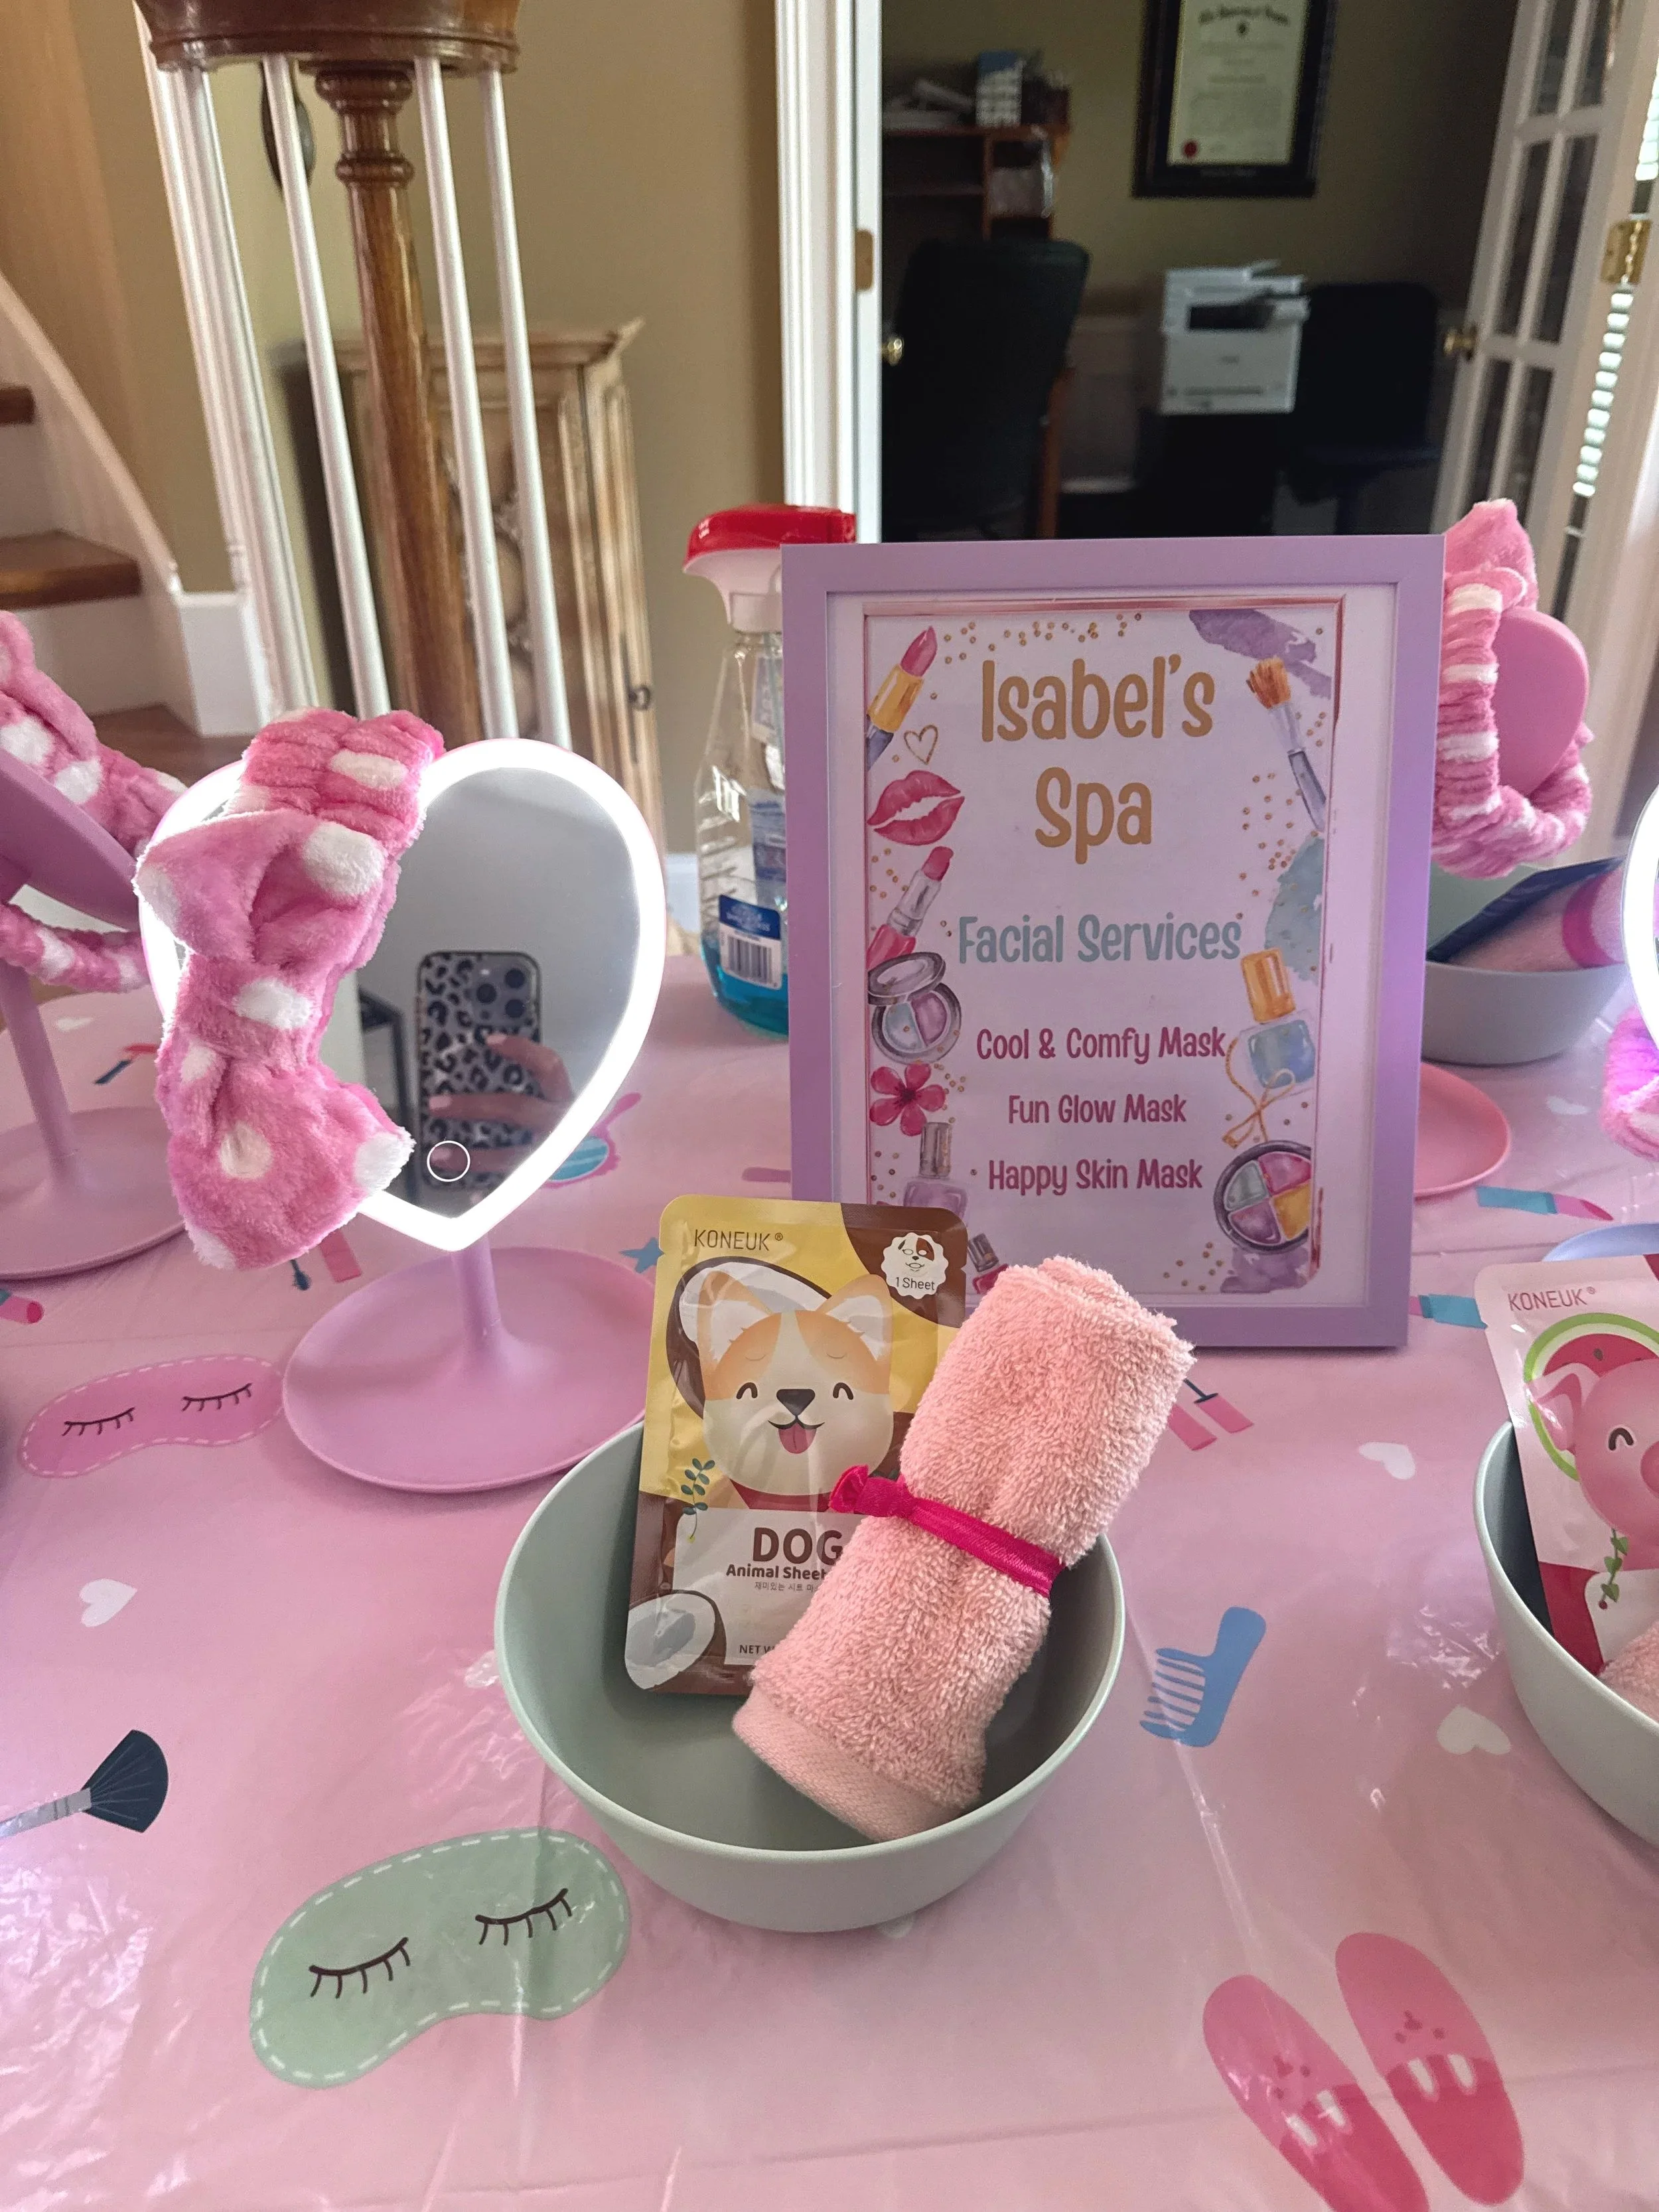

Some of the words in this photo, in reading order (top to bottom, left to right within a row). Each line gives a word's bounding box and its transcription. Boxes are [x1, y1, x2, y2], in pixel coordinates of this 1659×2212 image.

[981, 653, 1215, 742] Isabel's
[1035, 767, 1152, 865] Spa
[959, 915, 1064, 964] Facial
[1077, 912, 1242, 962] Services
[976, 1028, 1029, 1060] Cool
[1039, 1027, 1056, 1059] &
[1066, 1027, 1150, 1065] Comfy
[1158, 1026, 1226, 1058] Mask
[1008, 1094, 1050, 1124] Fun
[1058, 1094, 1116, 1124] Glow
[1123, 1093, 1188, 1123] Mask
[988, 1159, 1068, 1196] Happy
[1076, 1158, 1128, 1189] Skin
[1136, 1158, 1203, 1189] Mask
[895, 1276, 900, 1288] 1
[902, 1277, 935, 1291] Sheet
[753, 1527, 843, 1566] DOG
[726, 1563, 779, 1578] Animal
[755, 1582, 785, 1591] 재미있는
[788, 1583, 804, 1591] 시트
[806, 1584, 818, 1593] 마
[739, 1645, 761, 1654] NET
